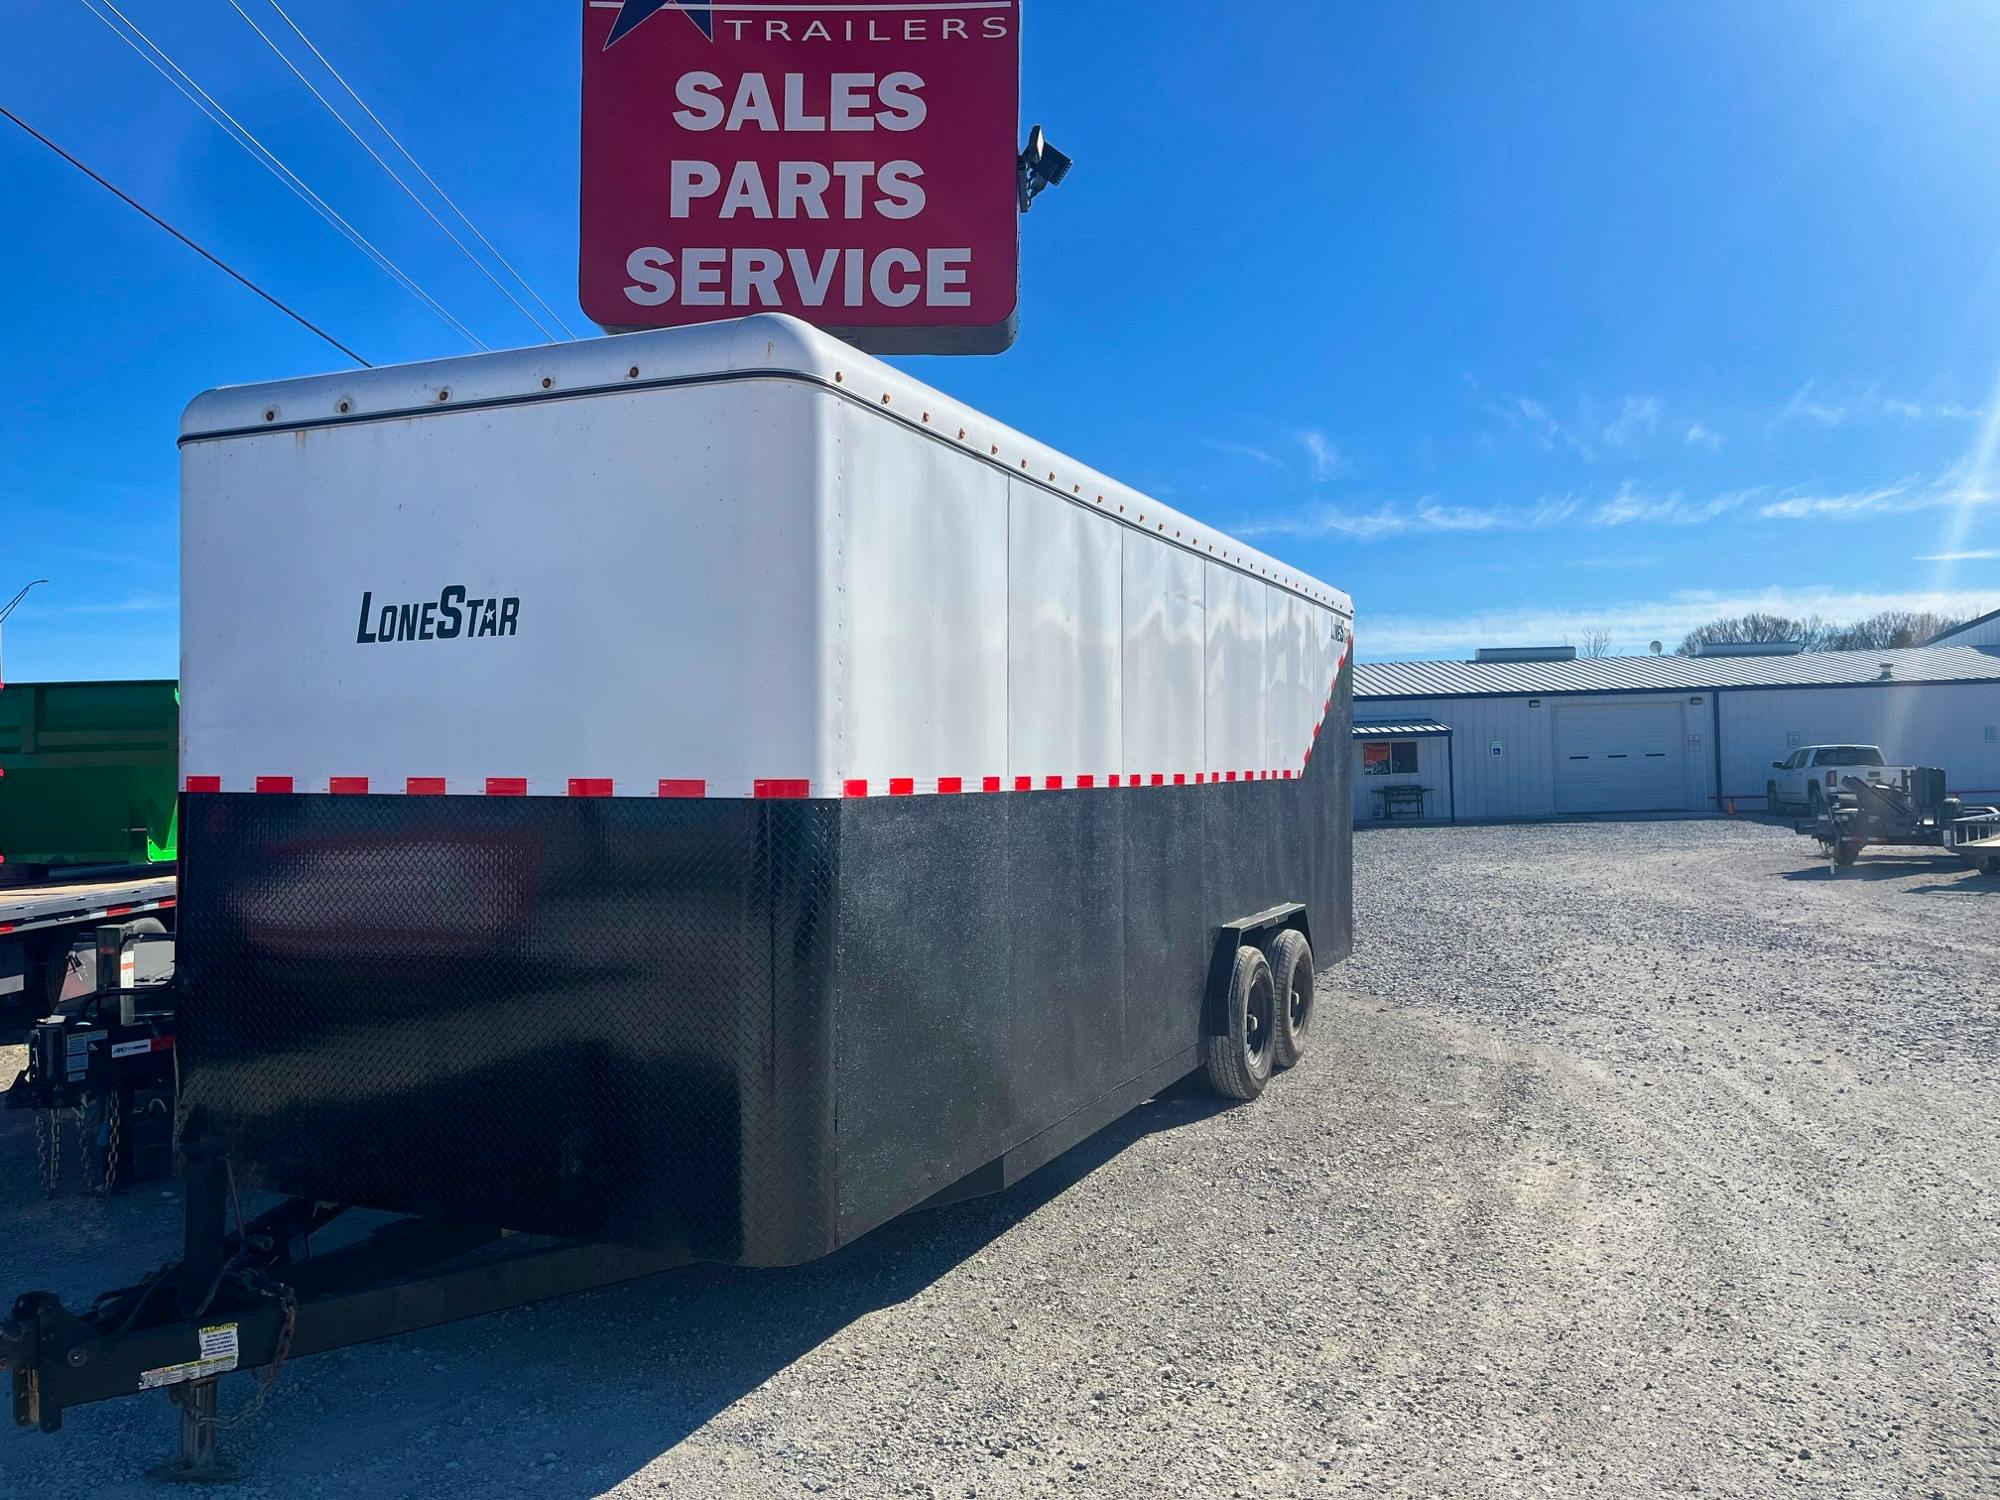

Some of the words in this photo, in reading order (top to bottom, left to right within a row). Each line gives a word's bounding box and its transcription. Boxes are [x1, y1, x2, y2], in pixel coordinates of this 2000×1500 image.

[723, 16, 1008, 42] TRAILERS
[672, 71, 928, 132] SALES
[669, 160, 927, 220] PARTS
[623, 246, 972, 308] SERVICE
[356, 584, 520, 644] LONESTAR
